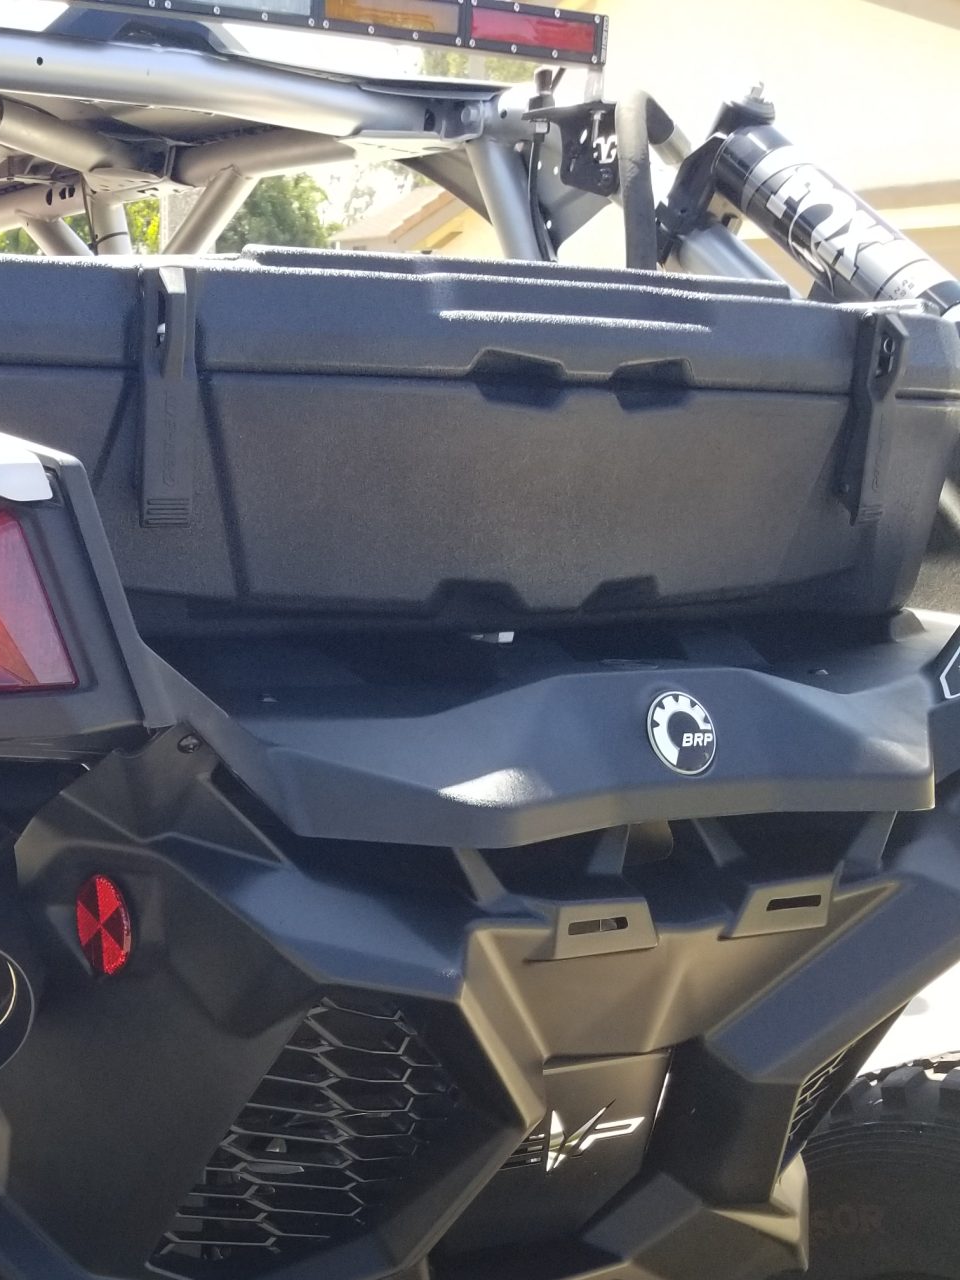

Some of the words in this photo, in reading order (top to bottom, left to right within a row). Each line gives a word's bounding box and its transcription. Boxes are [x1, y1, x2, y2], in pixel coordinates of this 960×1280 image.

[766, 165, 897, 284] FOX
[682, 732, 714, 747] BRP
[811, 1203, 885, 1241] SOR
